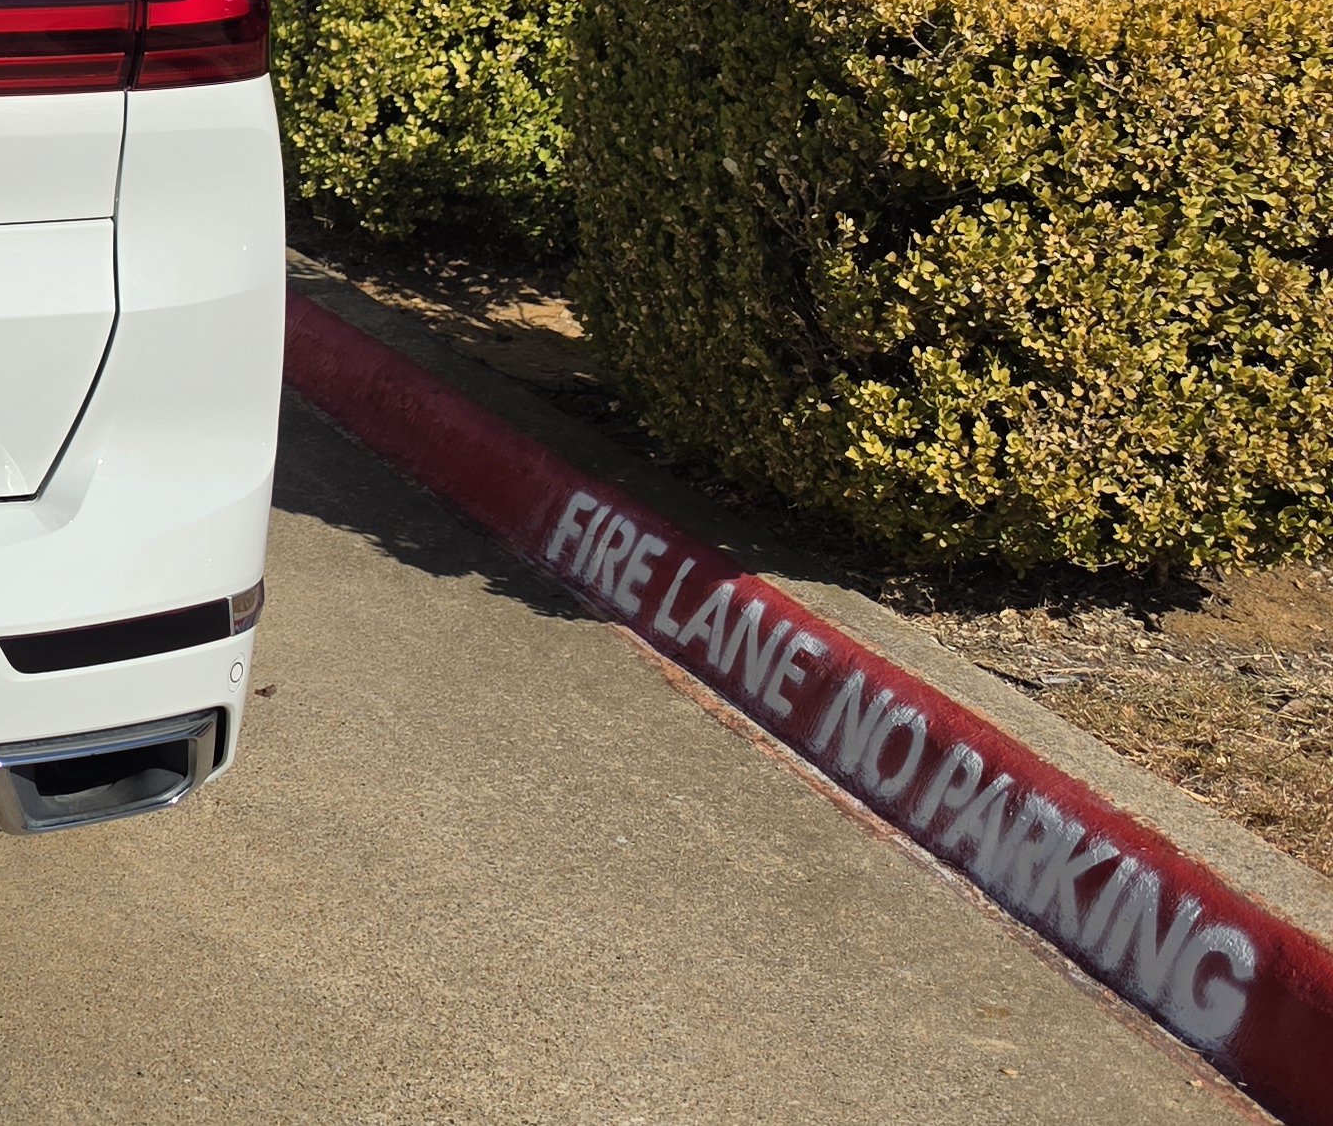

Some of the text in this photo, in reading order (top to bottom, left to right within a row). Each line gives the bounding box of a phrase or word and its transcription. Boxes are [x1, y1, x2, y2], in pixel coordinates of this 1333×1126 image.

[545, 488, 1259, 1050] FIRE LANE NO PARKING
